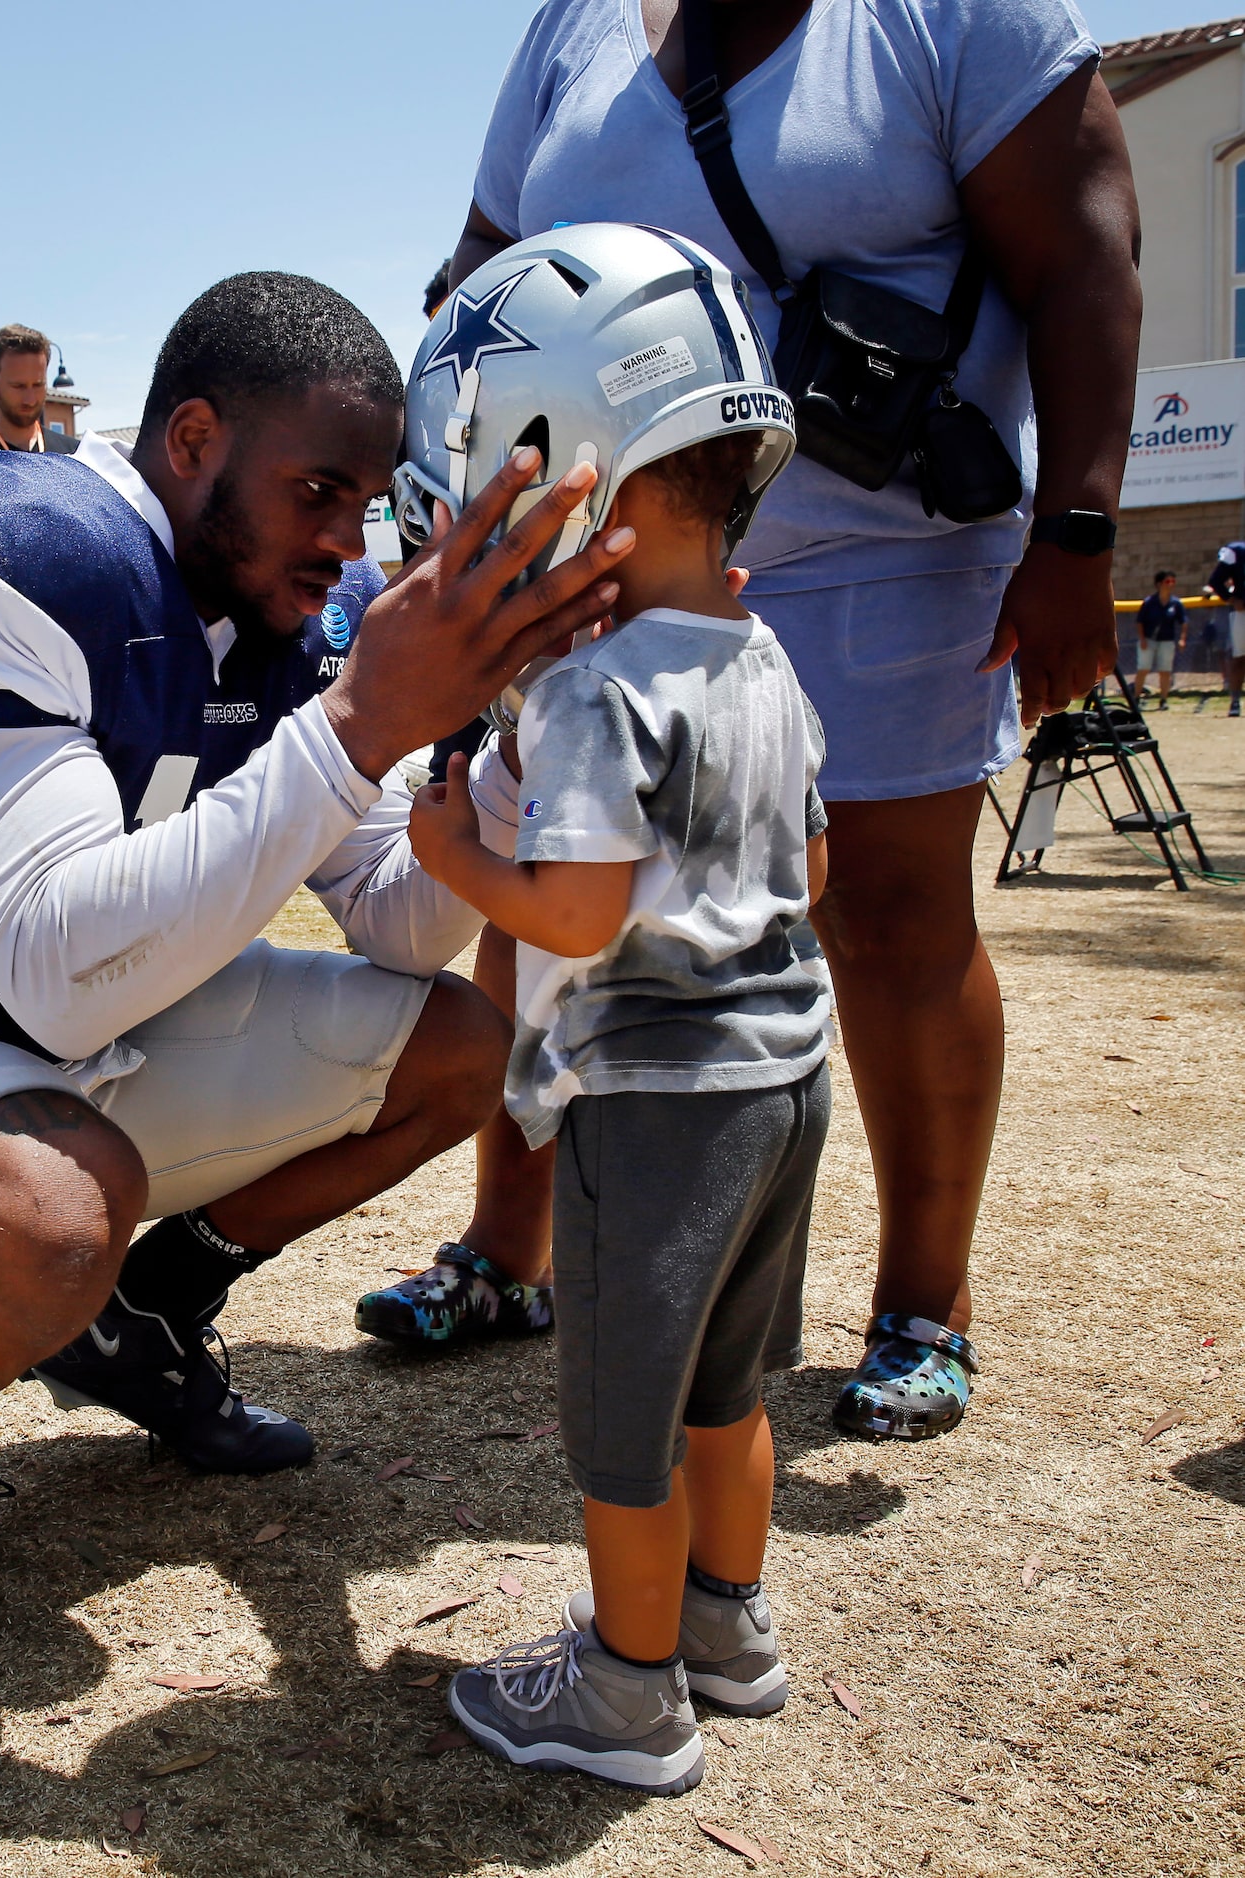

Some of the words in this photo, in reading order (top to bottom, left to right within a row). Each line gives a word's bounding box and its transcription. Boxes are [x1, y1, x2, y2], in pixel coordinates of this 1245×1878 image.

[620, 345, 666, 371] WARNING
[613, 374, 629, 383] REPLICA
[629, 367, 643, 376] HELMET
[616, 377, 635, 388] DESIGNED
[720, 392, 795, 430] COWBOY
[1130, 424, 1234, 448] cademy
[317, 655, 348, 678] AT&
[204, 702, 259, 723] WBOYS
[197, 1220, 245, 1255] GRIP
